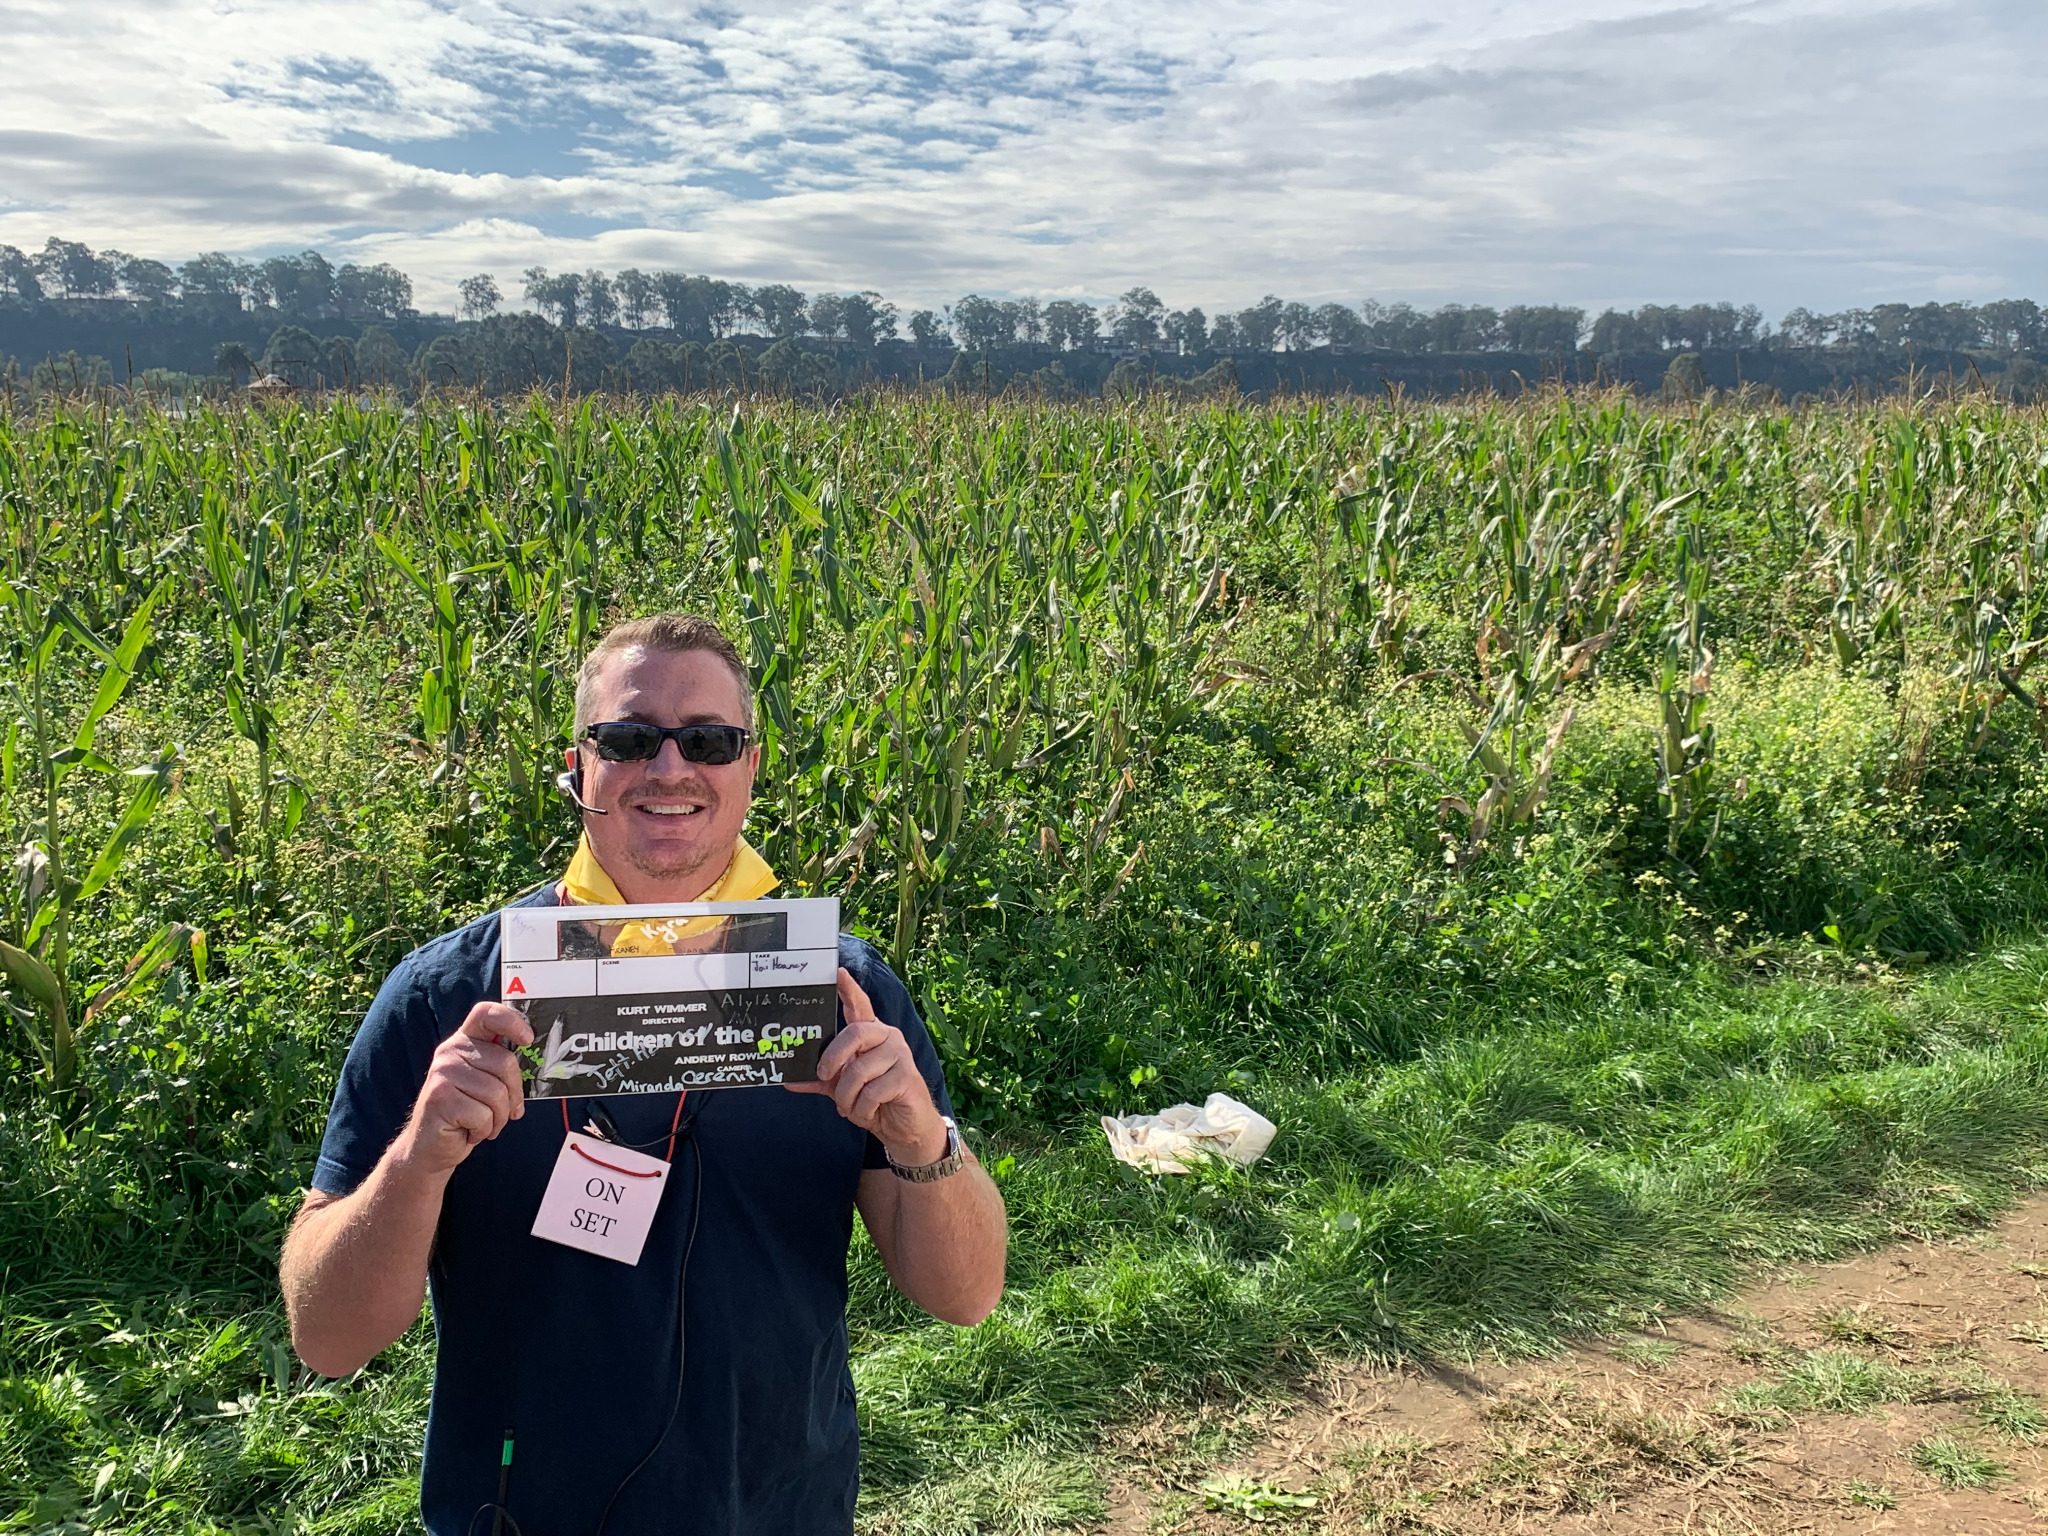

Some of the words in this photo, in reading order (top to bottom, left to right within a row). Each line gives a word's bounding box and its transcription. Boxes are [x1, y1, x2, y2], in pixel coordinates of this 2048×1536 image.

[640, 918, 689, 943] Kyra
[506, 976, 526, 994] A
[617, 1005, 650, 1015] KURT
[654, 1003, 707, 1014] WIMMER
[642, 1017, 685, 1025] DIRECTOR
[571, 1030, 674, 1052] Children
[679, 1026, 708, 1047] of
[714, 1026, 754, 1045] the
[761, 1023, 822, 1042] Corn
[675, 1054, 726, 1065] ANDREW
[729, 1050, 794, 1061] ROWLANDS
[717, 1064, 752, 1072] CAMERA
[618, 1075, 684, 1093] Miranda
[585, 1178, 626, 1205] ON
[570, 1208, 617, 1237] SET
